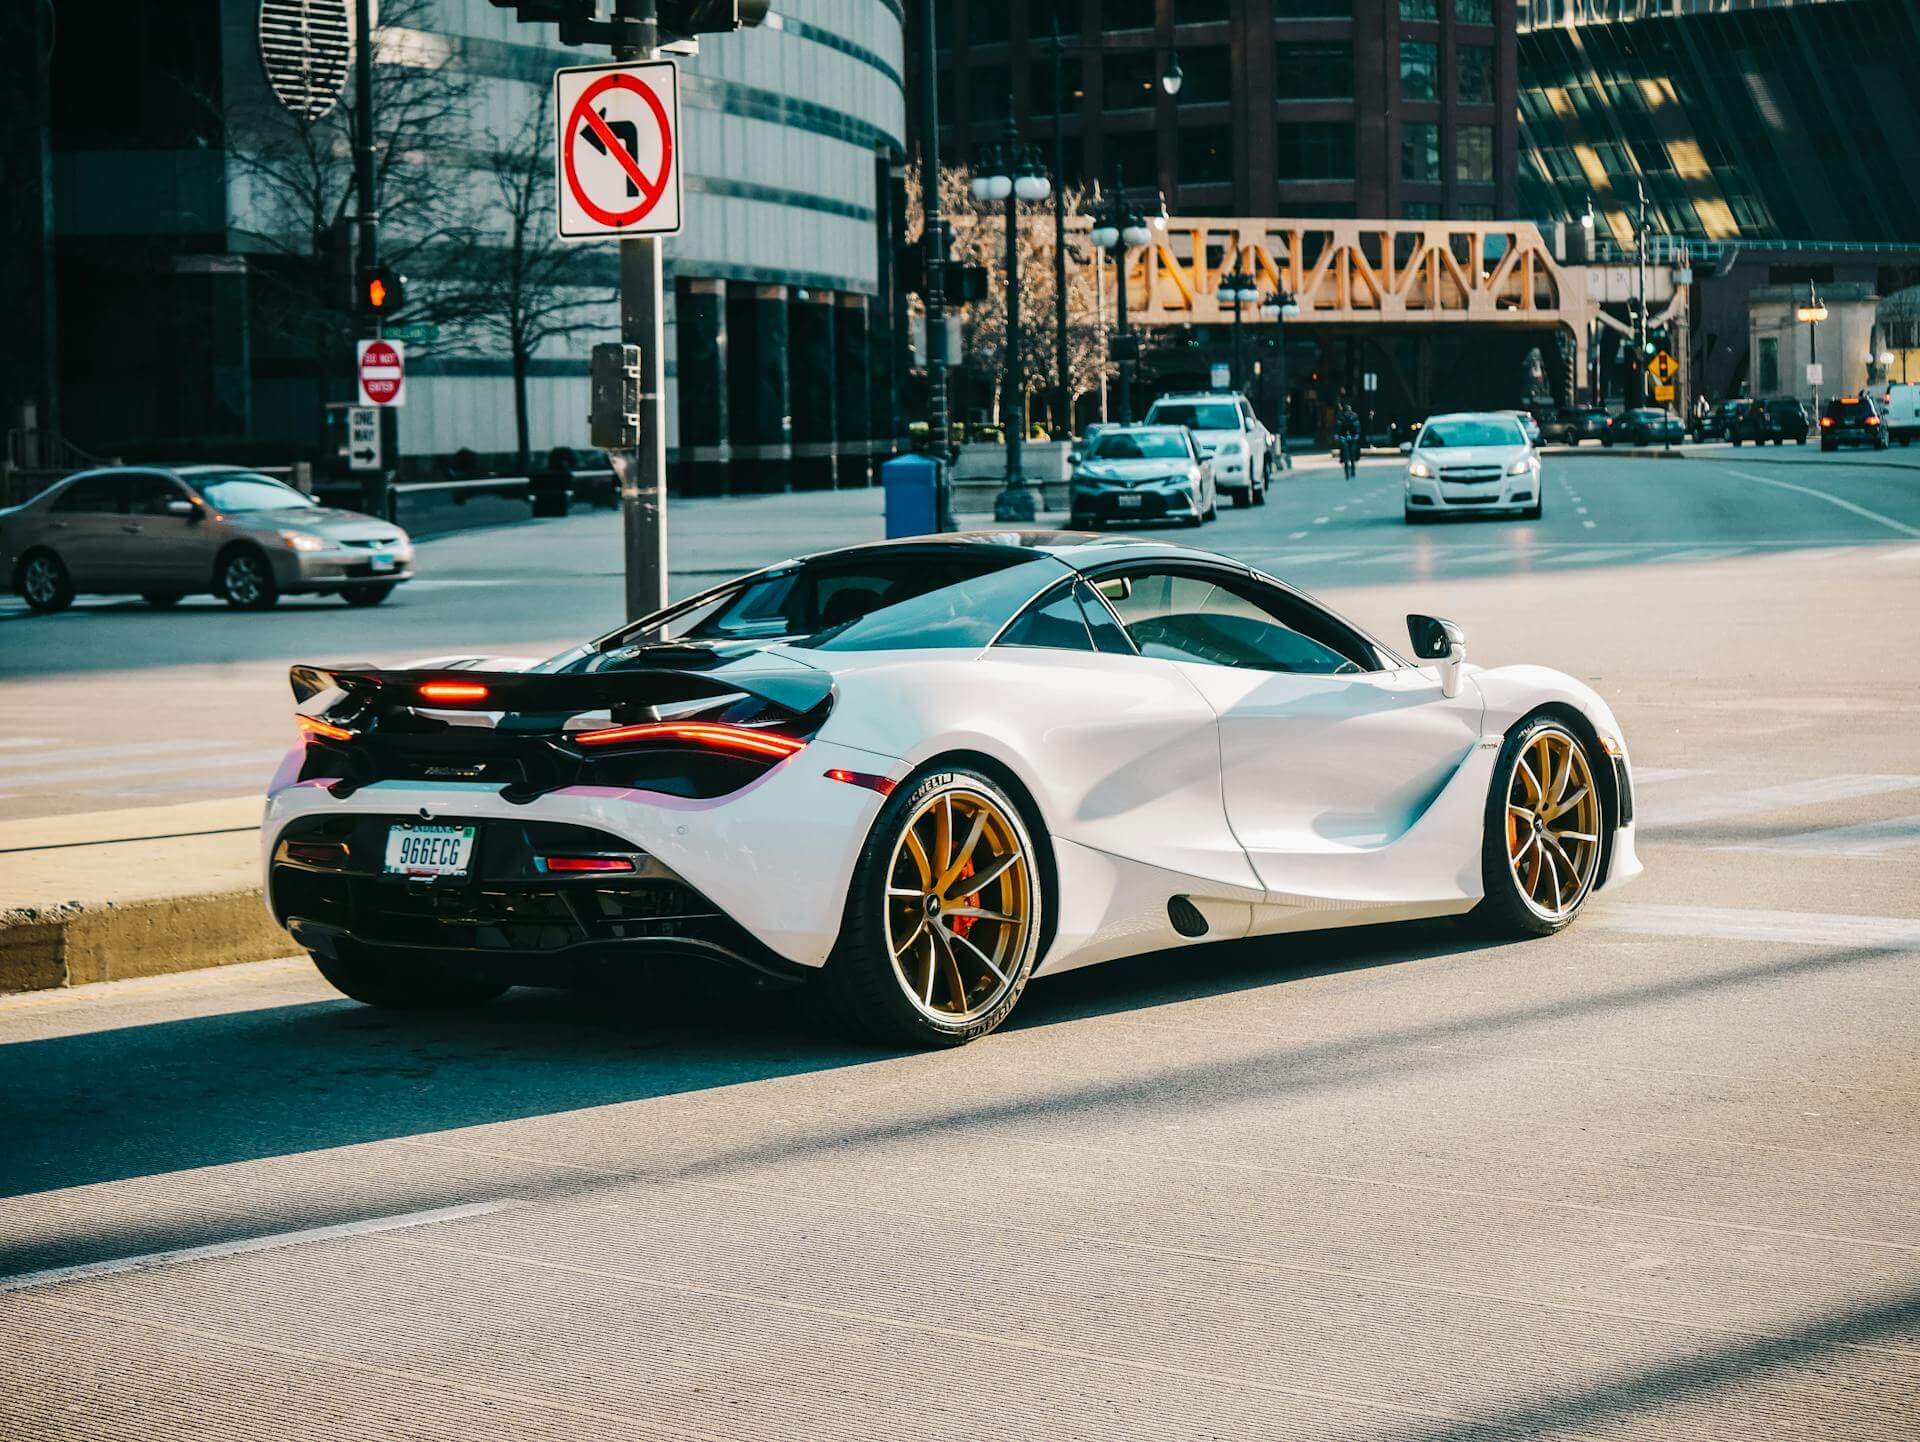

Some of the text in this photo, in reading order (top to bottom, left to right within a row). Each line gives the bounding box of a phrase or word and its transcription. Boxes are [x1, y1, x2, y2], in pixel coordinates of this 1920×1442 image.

[368, 381, 394, 393] ENTER
[354, 411, 375, 425] ONE
[354, 429, 374, 442] WAY
[400, 837, 460, 865] 966ECG
